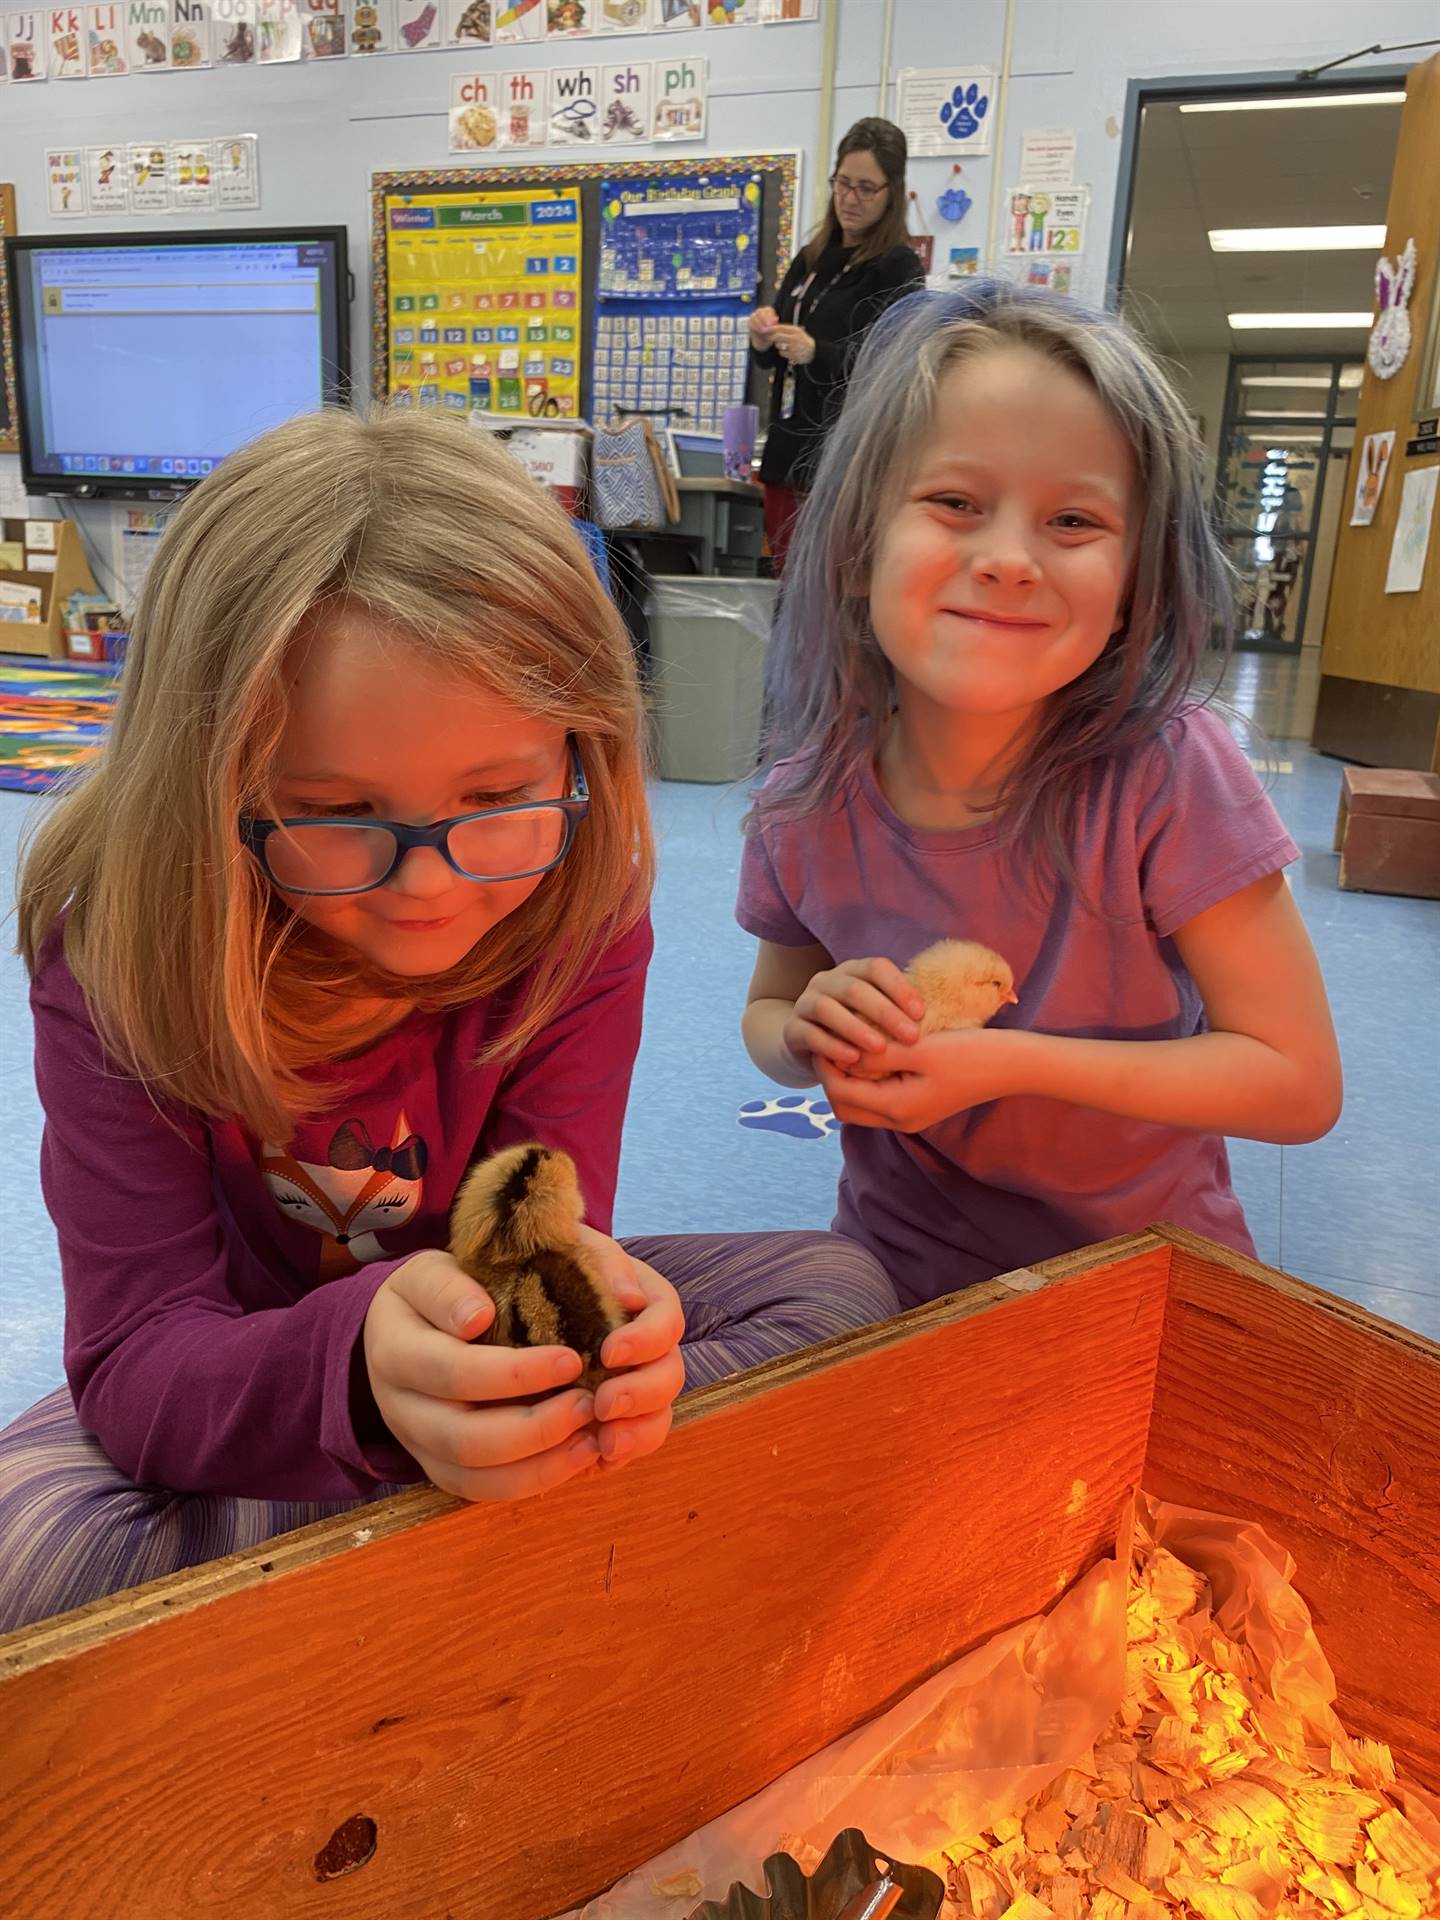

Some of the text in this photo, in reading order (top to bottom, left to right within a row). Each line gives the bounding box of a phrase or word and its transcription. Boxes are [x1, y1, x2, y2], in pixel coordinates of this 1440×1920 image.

[15, 15, 34, 41] Jj
[51, 10, 80, 33] Kk
[95, 6, 115, 30] Ll
[129, 2, 166, 25] Mm
[174, 0, 204, 23] Nn
[461, 63, 695, 102] ch th wh sh ph
[392, 205, 573, 224] Winter March 2024
[533, 259, 571, 272] 1 2
[400, 299, 411, 310] 3
[424, 297, 434, 308] 4
[479, 297, 488, 308] 6
[503, 295, 515, 308] 7
[531, 296, 541, 307] 8
[558, 294, 570, 305] 9
[447, 330, 463, 342] 12
[475, 330, 491, 342] 13
[499, 329, 515, 341] 14
[553, 362, 570, 374] 23
